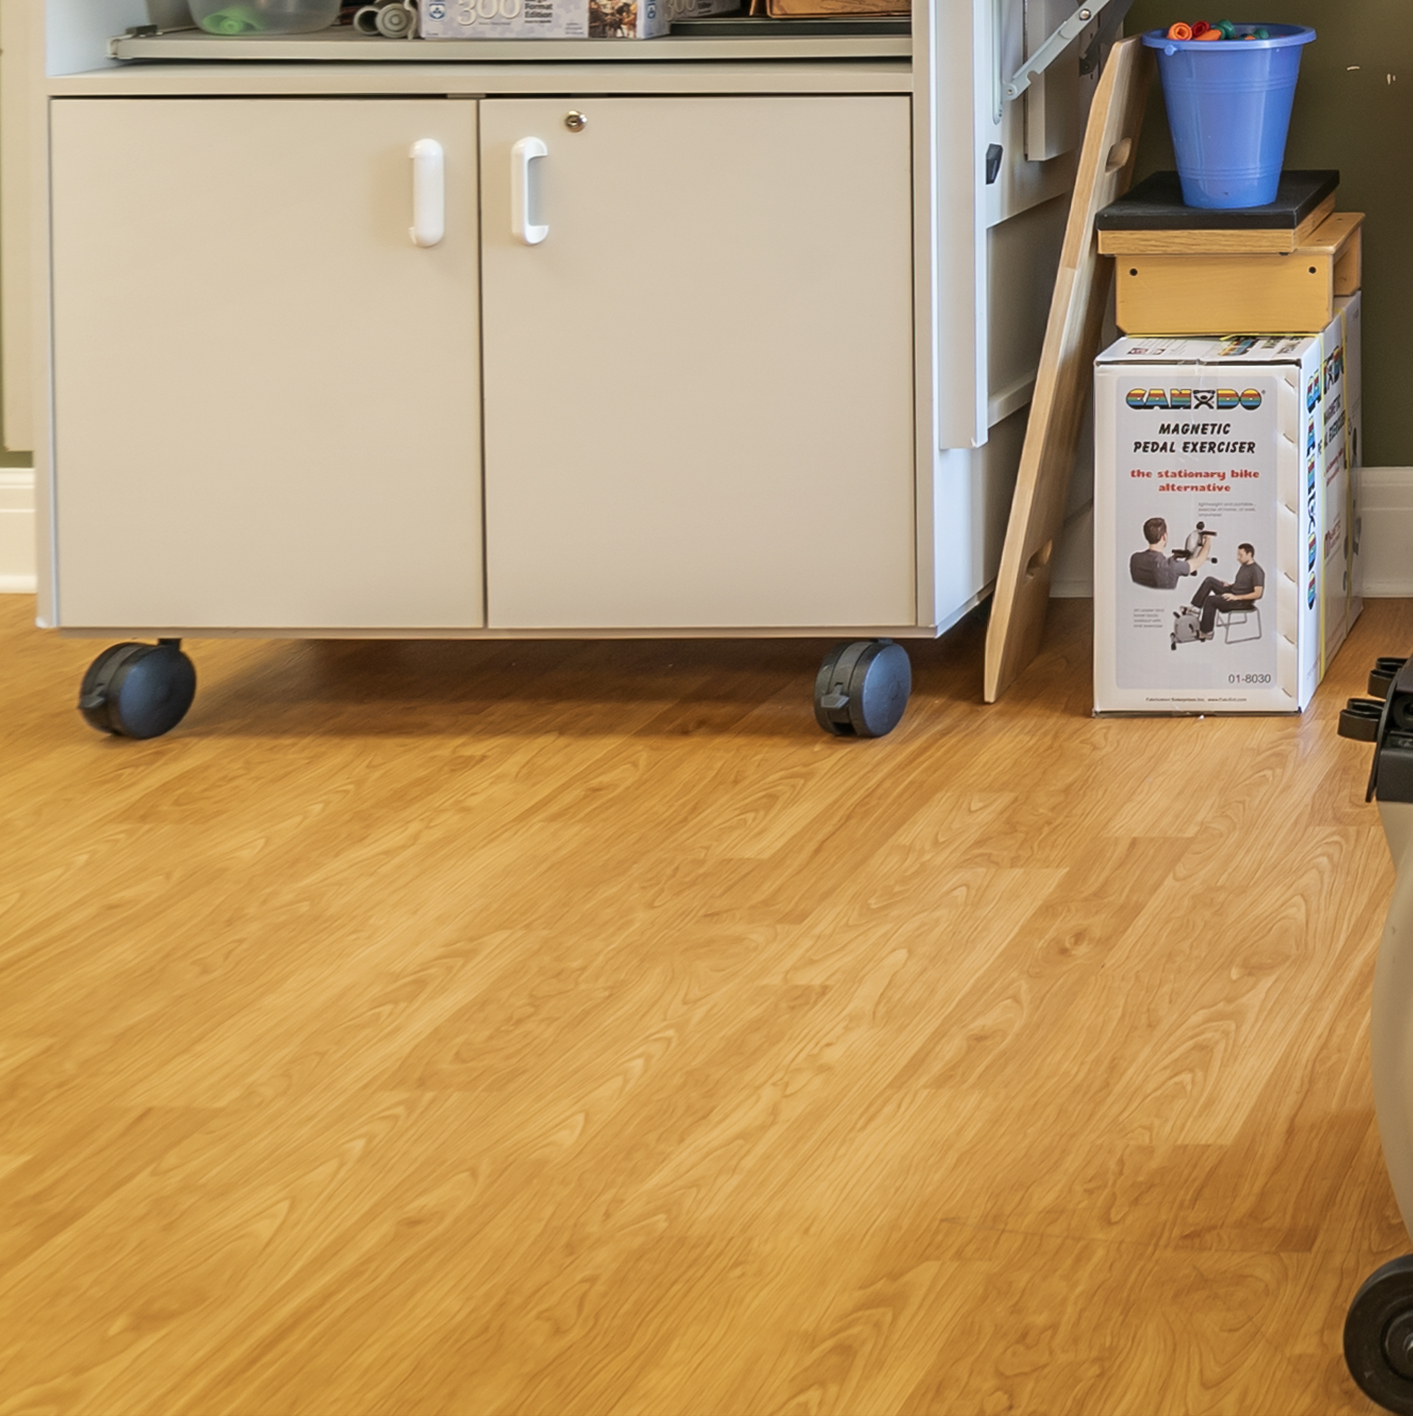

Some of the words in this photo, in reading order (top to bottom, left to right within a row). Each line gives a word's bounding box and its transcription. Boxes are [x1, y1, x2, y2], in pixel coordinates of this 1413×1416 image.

[1158, 423, 1231, 435] MAGNETIC
[1134, 441, 1176, 453] PEDAL
[1182, 441, 1256, 454] EXERCISER
[1130, 469, 1152, 478] the
[1157, 469, 1226, 481] stationary
[1231, 469, 1259, 478] bike
[1158, 483, 1231, 492] alternative
[1228, 674, 1271, 684] 01-8030
